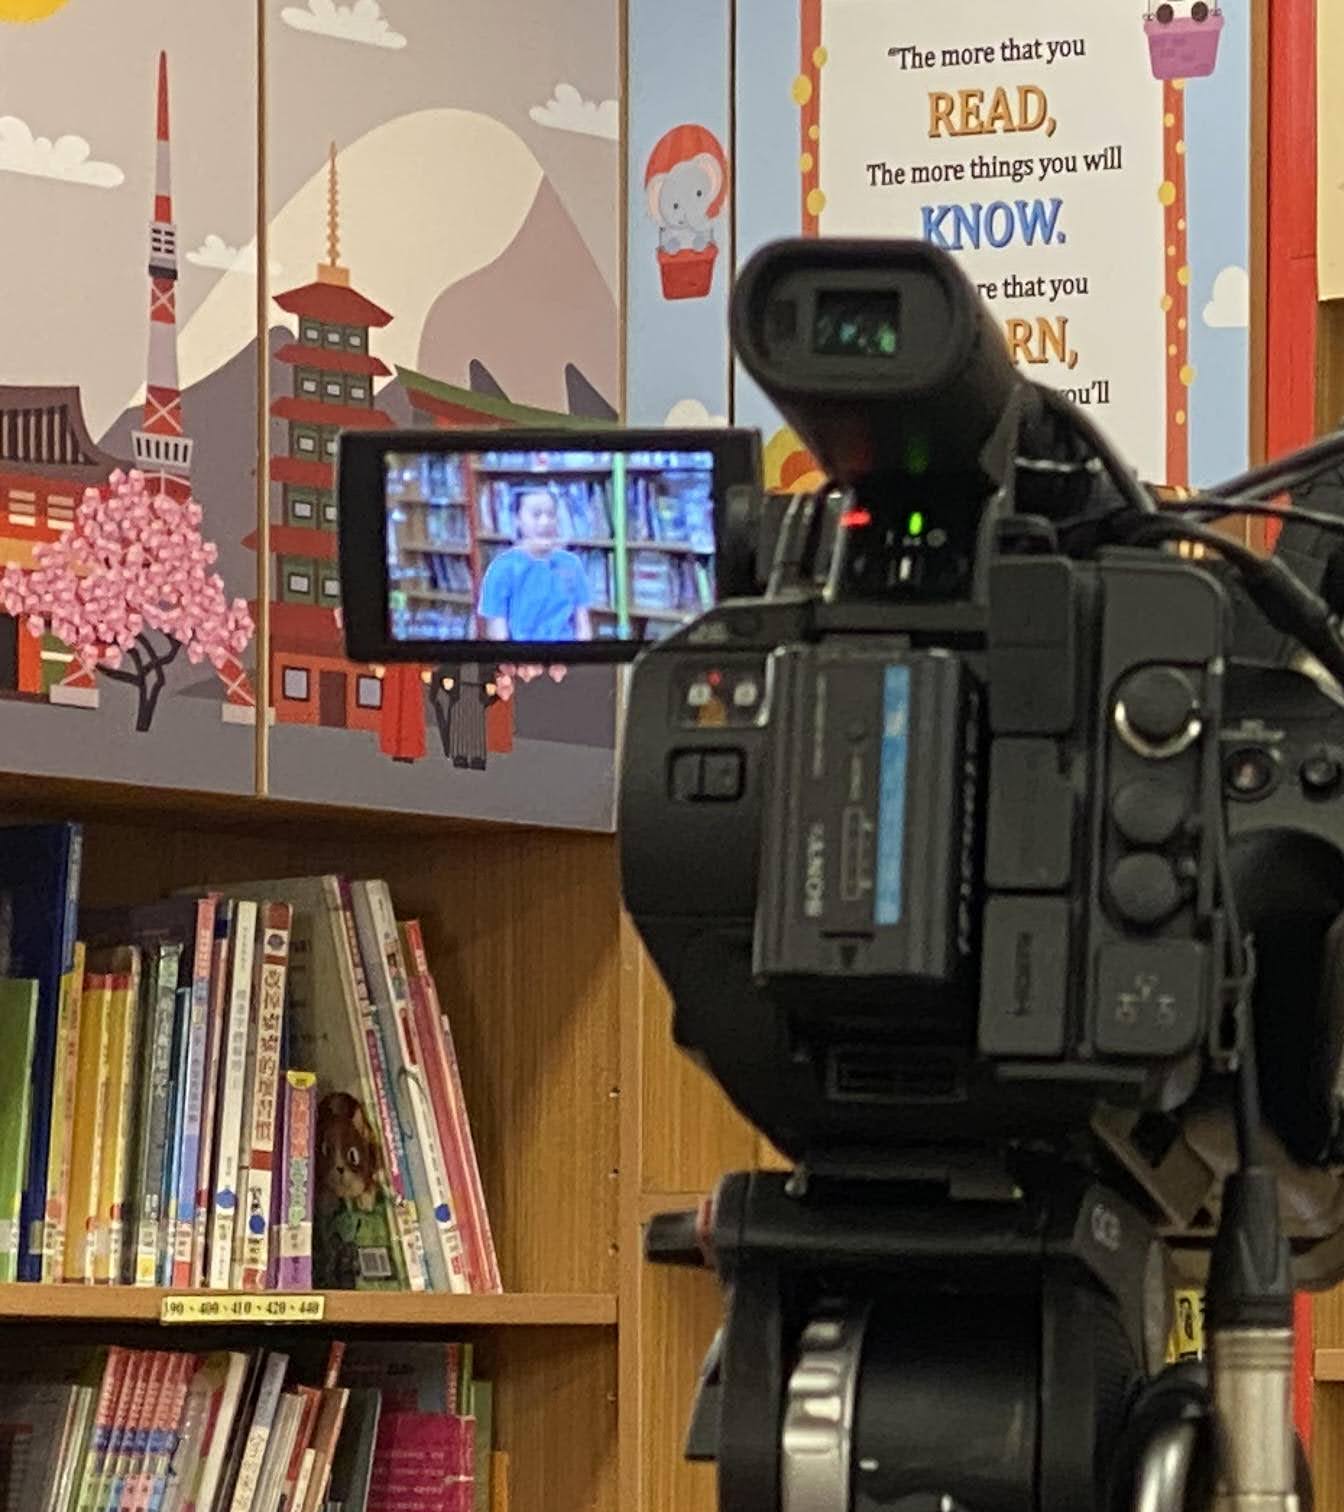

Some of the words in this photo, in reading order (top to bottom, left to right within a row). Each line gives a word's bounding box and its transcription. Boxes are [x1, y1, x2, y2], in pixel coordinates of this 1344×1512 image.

[941, 43, 996, 68] more
[1000, 38, 1043, 62] that
[1046, 36, 1086, 67] you
[927, 84, 1058, 138] READ,
[866, 162, 905, 186] The
[911, 160, 965, 184] more
[970, 155, 1034, 183] things
[1039, 156, 1078, 183] you
[1083, 146, 1123, 171] will
[920, 198, 1067, 250] KNOW.
[976, 278, 998, 300] re
[1002, 275, 1046, 298] that
[1049, 277, 1089, 303] you
